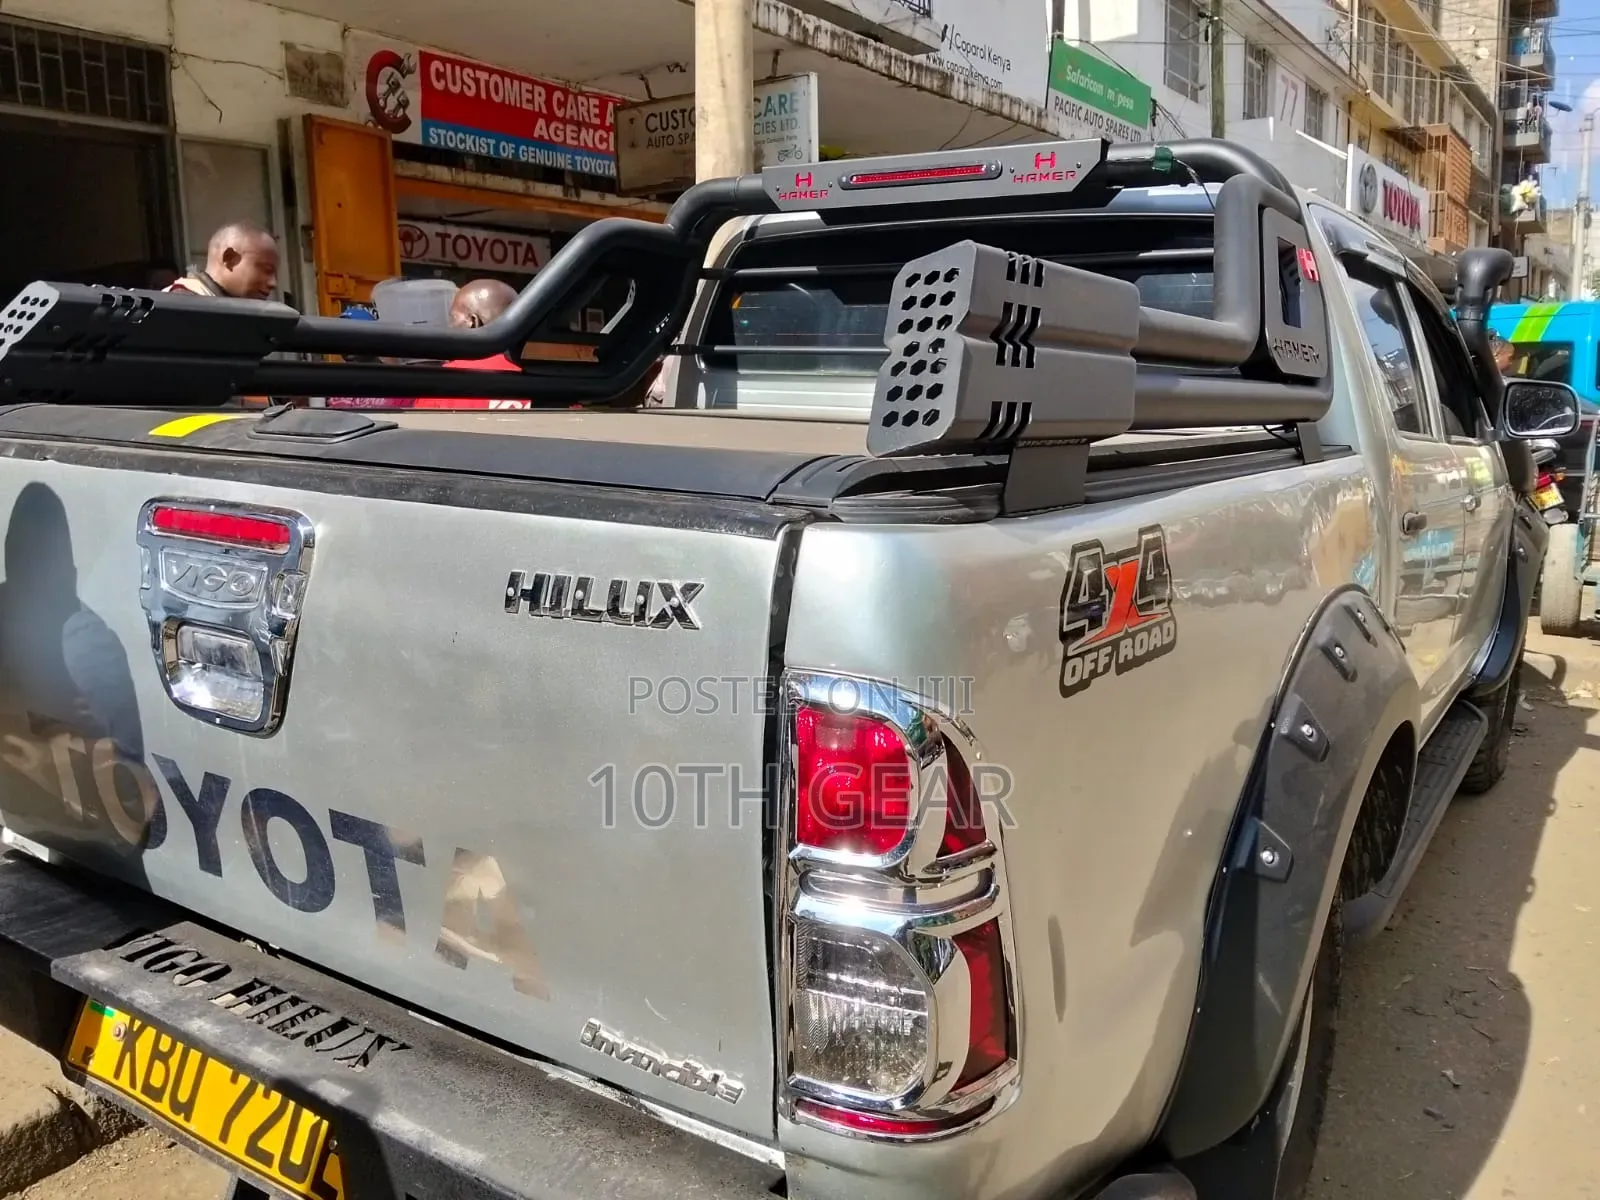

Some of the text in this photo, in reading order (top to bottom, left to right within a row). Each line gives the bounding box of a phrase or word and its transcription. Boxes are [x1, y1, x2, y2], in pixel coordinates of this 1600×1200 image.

[988, 46, 1011, 74] Kenya
[1066, 64, 1104, 96] Safaricom
[430, 60, 547, 114] CUSTOMER
[552, 90, 600, 124] CARE
[1054, 96, 1082, 121] PACIFIC
[1083, 109, 1103, 129] AUTO
[1105, 118, 1129, 140] SPARES
[429, 127, 617, 177] STOCKIST OF GENUINE TOYOTA
[646, 134, 675, 149] AUTO
[777, 189, 829, 201] HAMER
[1012, 170, 1077, 184] HAMER
[1383, 178, 1421, 233] TOYOTA
[435, 232, 539, 267] TOYOTA
[1273, 337, 1320, 364] HAMER
[168, 560, 256, 598] VIGO
[504, 570, 705, 630] HILUX
[1063, 620, 1175, 687] OFF ROAD
[27, 711, 551, 1000] TOYOTA
[113, 1015, 203, 1124] KBU
